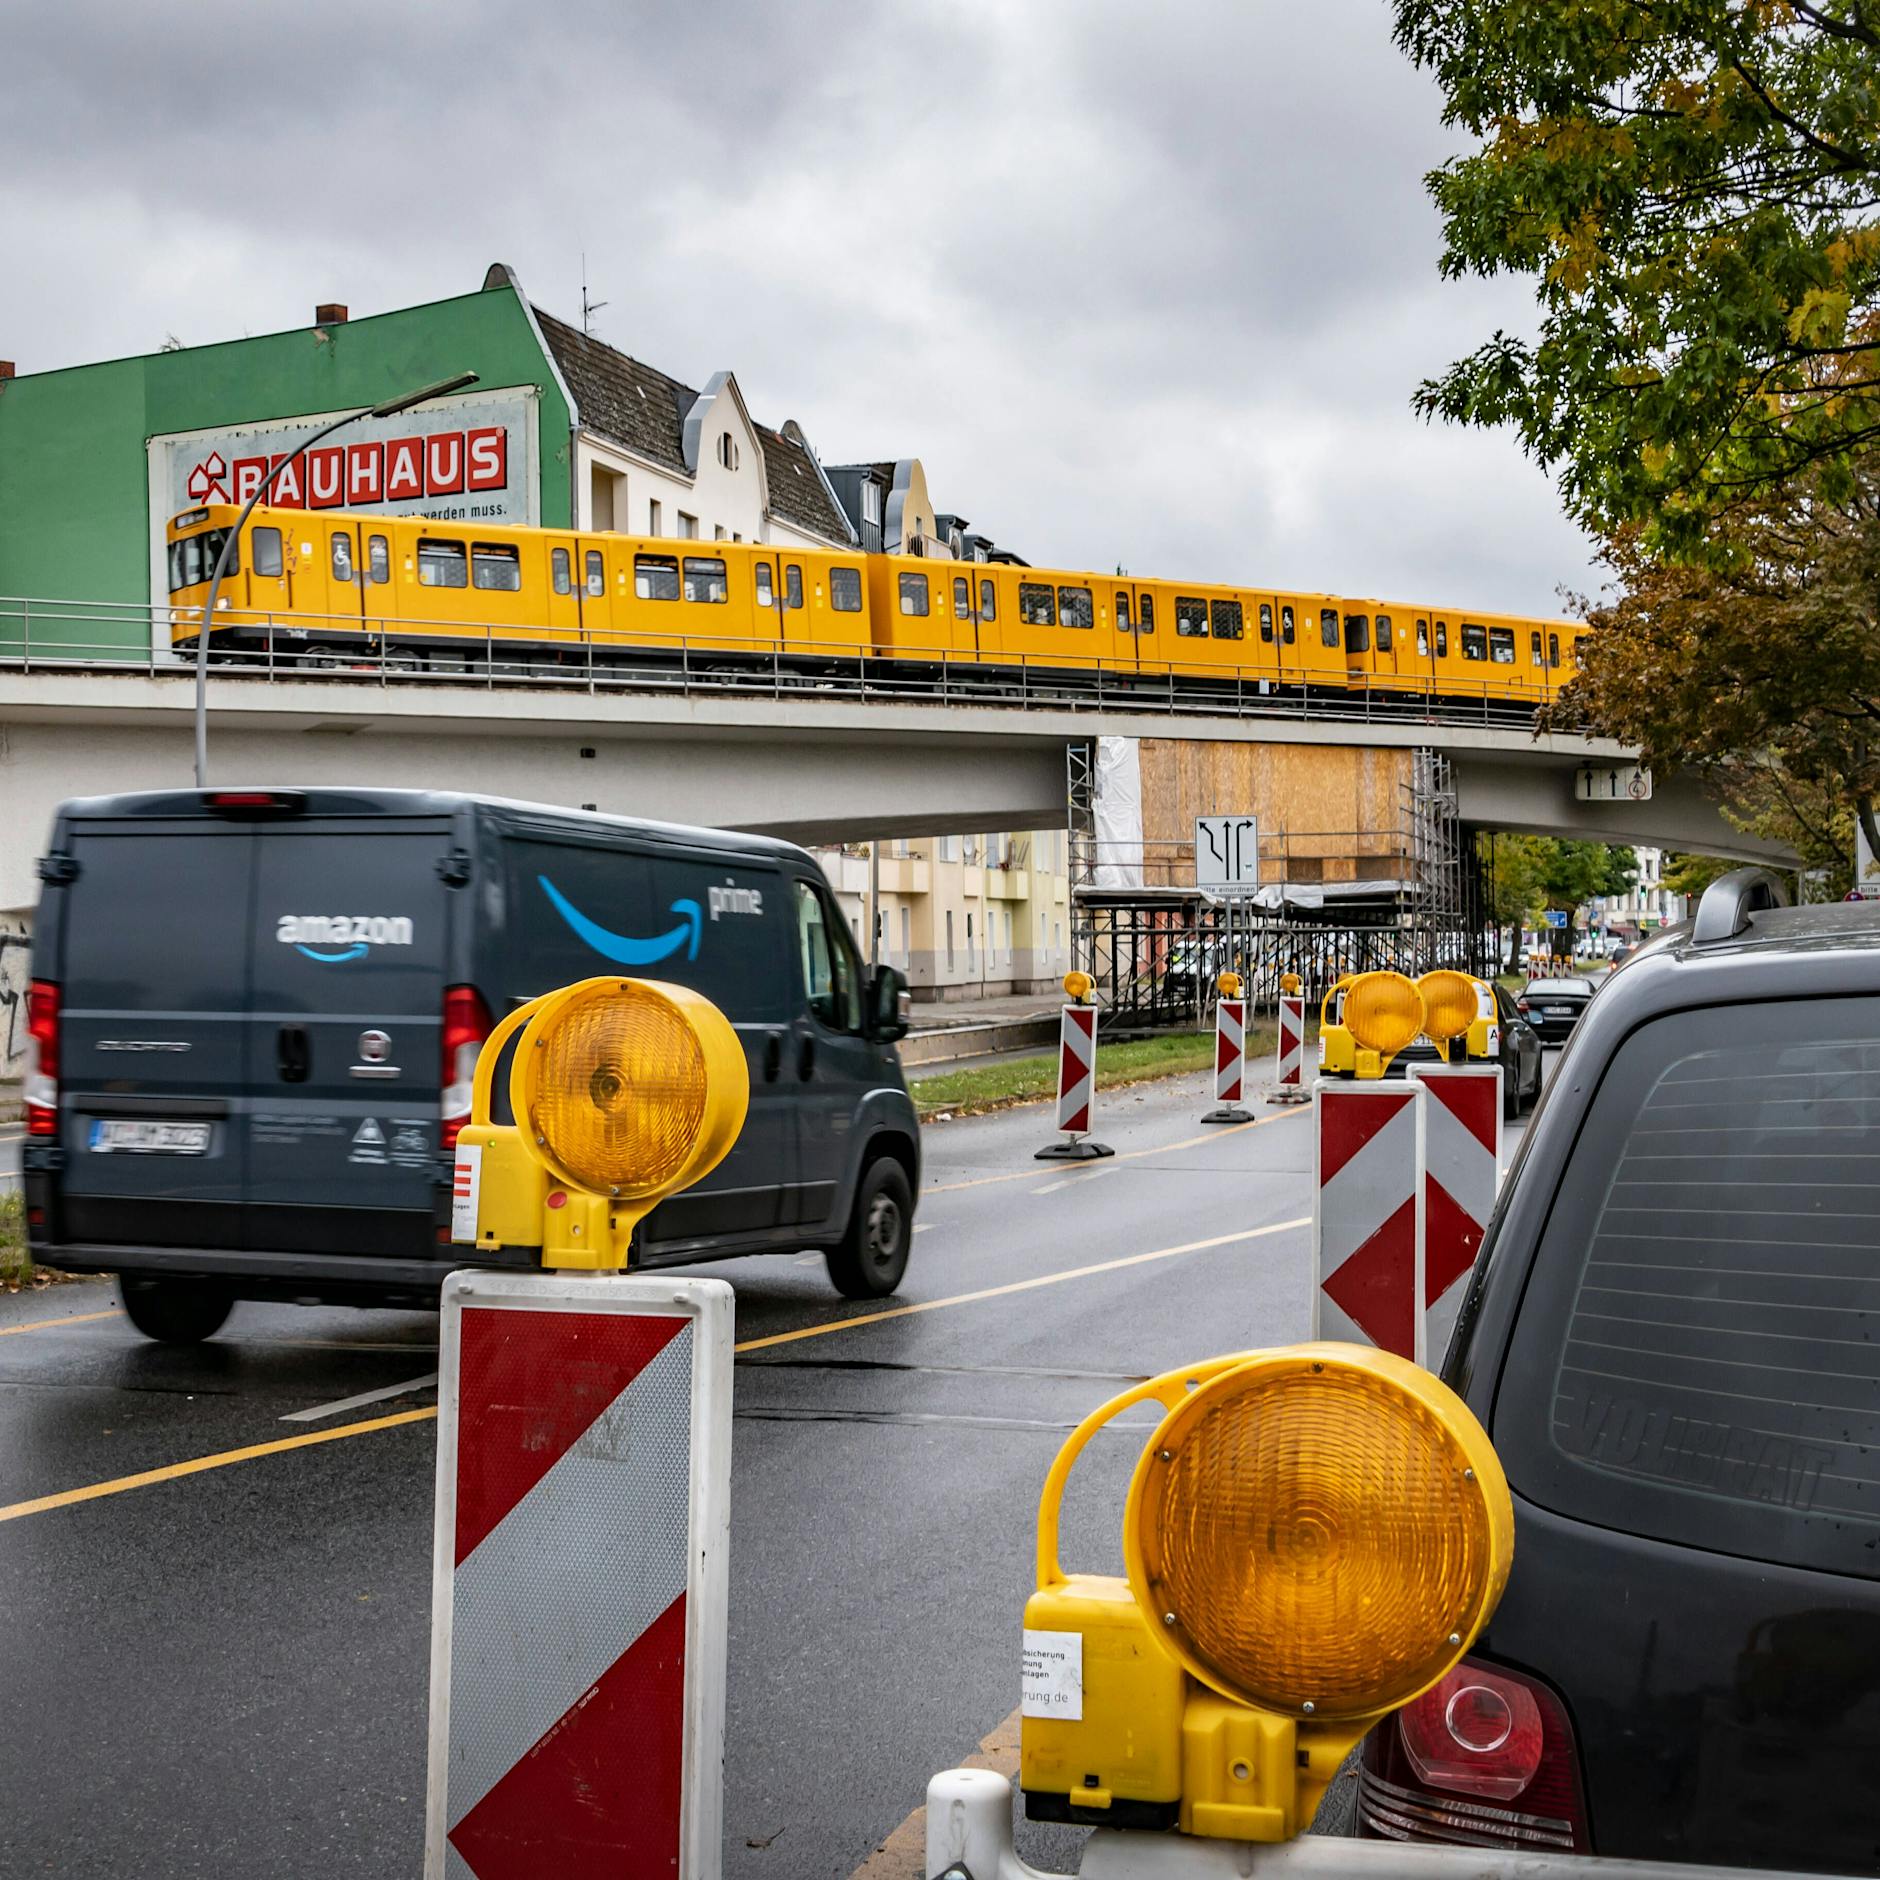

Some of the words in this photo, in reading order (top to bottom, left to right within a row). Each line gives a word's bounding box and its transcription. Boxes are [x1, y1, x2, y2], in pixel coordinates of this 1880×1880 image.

[238, 434, 501, 506] BAUHAUS
[471, 504, 508, 518] muss.
[708, 877, 763, 921] prime
[276, 915, 413, 945] amazon
